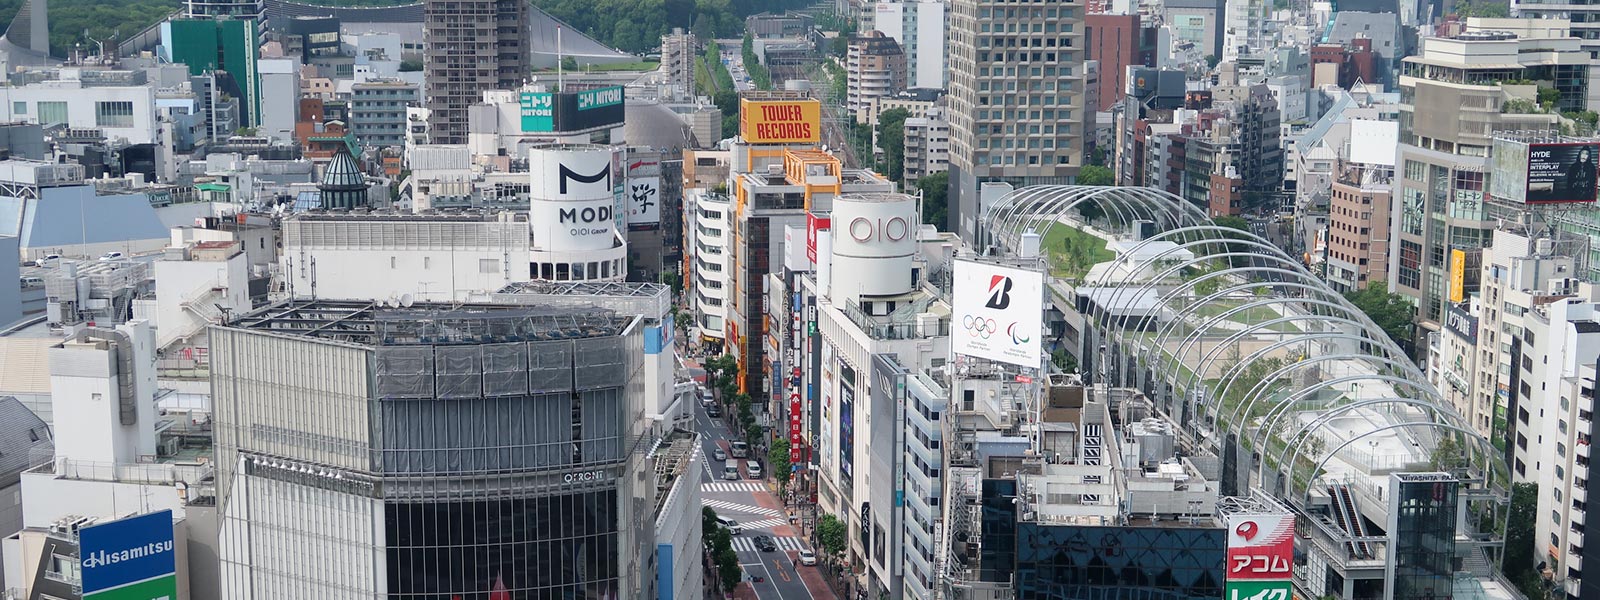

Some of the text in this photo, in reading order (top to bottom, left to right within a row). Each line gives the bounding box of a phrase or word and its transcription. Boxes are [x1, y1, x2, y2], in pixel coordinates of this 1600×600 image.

[522, 96, 552, 107] ニトリ
[596, 88, 621, 105] NITORI
[761, 105, 802, 121] TOWER
[757, 123, 811, 139] RECORDS
[560, 205, 612, 224] MODI
[564, 471, 604, 484] QFRONT
[82, 540, 172, 568] Hisamitsu
[1232, 555, 1289, 572] アコム
